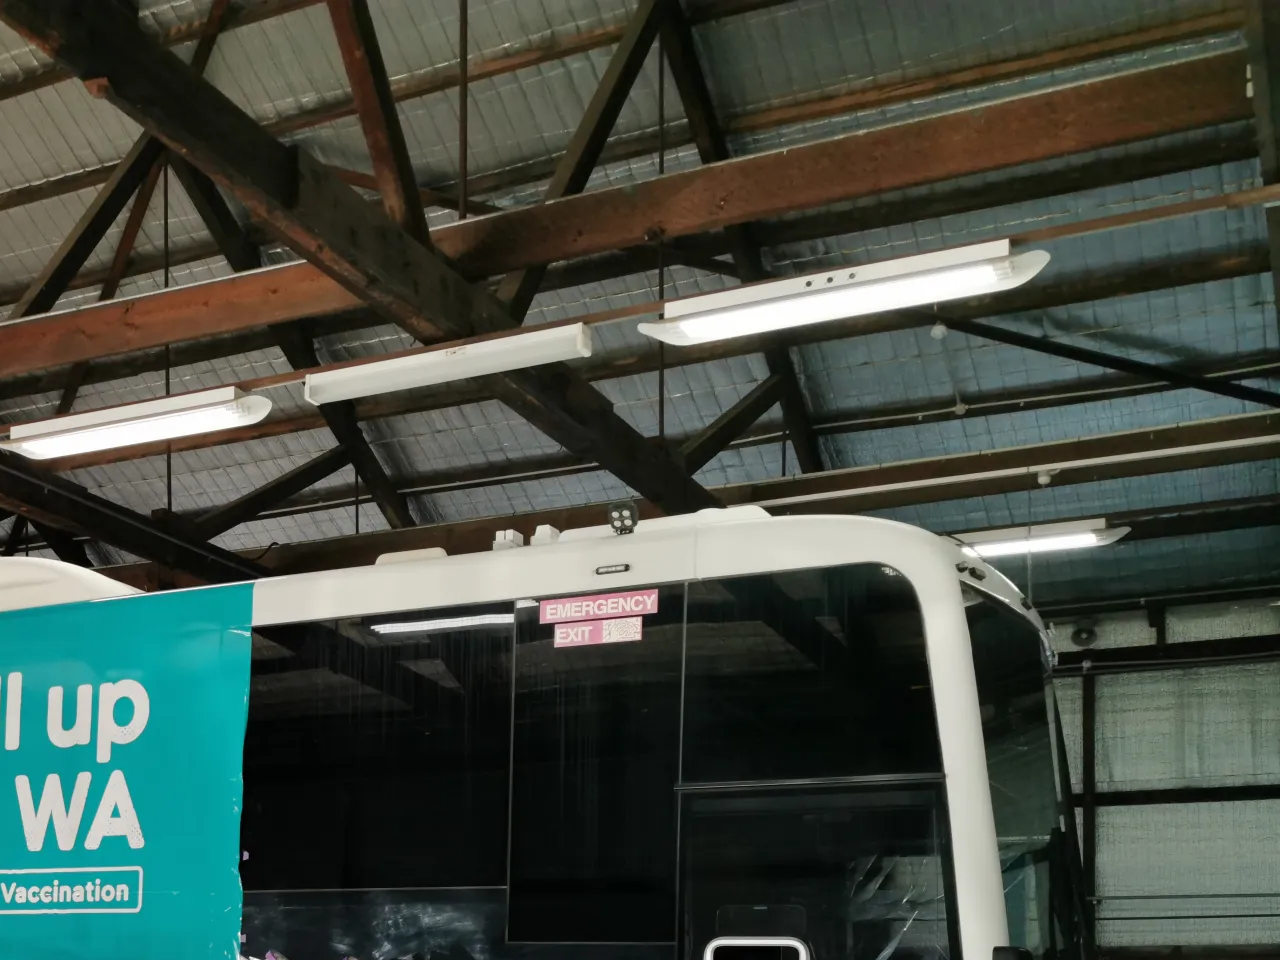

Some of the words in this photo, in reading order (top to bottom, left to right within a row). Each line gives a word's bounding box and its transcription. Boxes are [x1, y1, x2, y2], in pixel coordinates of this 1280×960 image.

[545, 595, 656, 620] EMERGENCY
[555, 626, 593, 644] EXIT
[46, 679, 150, 764] up
[14, 769, 145, 852] WA
[0, 878, 130, 904] Vaccination
